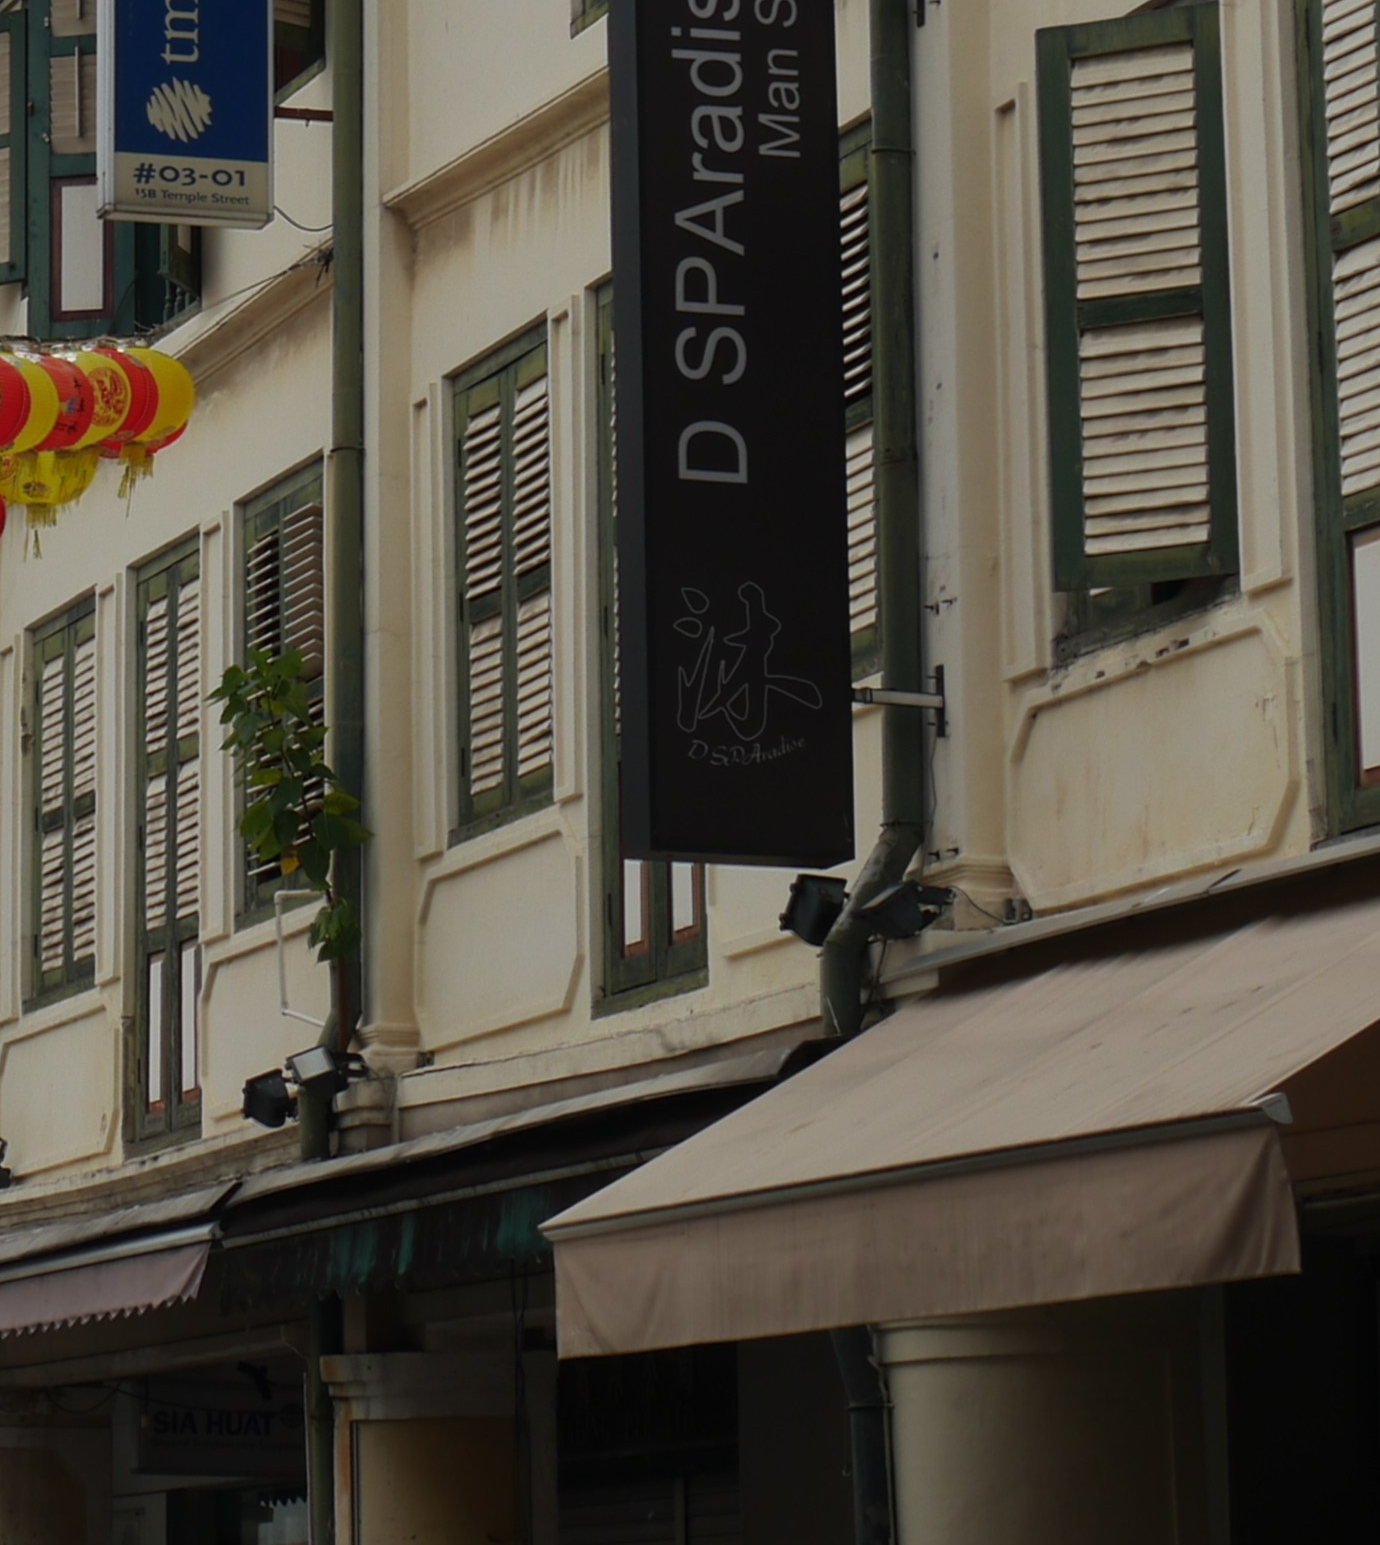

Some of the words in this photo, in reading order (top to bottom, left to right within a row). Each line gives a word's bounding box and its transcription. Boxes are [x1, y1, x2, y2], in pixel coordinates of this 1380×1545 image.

[757, 47, 802, 159] Man
[132, 162, 246, 188] #03-01
[134, 187, 158, 200] 15B
[160, 188, 208, 205] Temple
[210, 192, 250, 206] Street
[677, 420, 749, 485] D
[152, 1410, 198, 1435] SIA
[206, 1410, 274, 1437] HUAT
